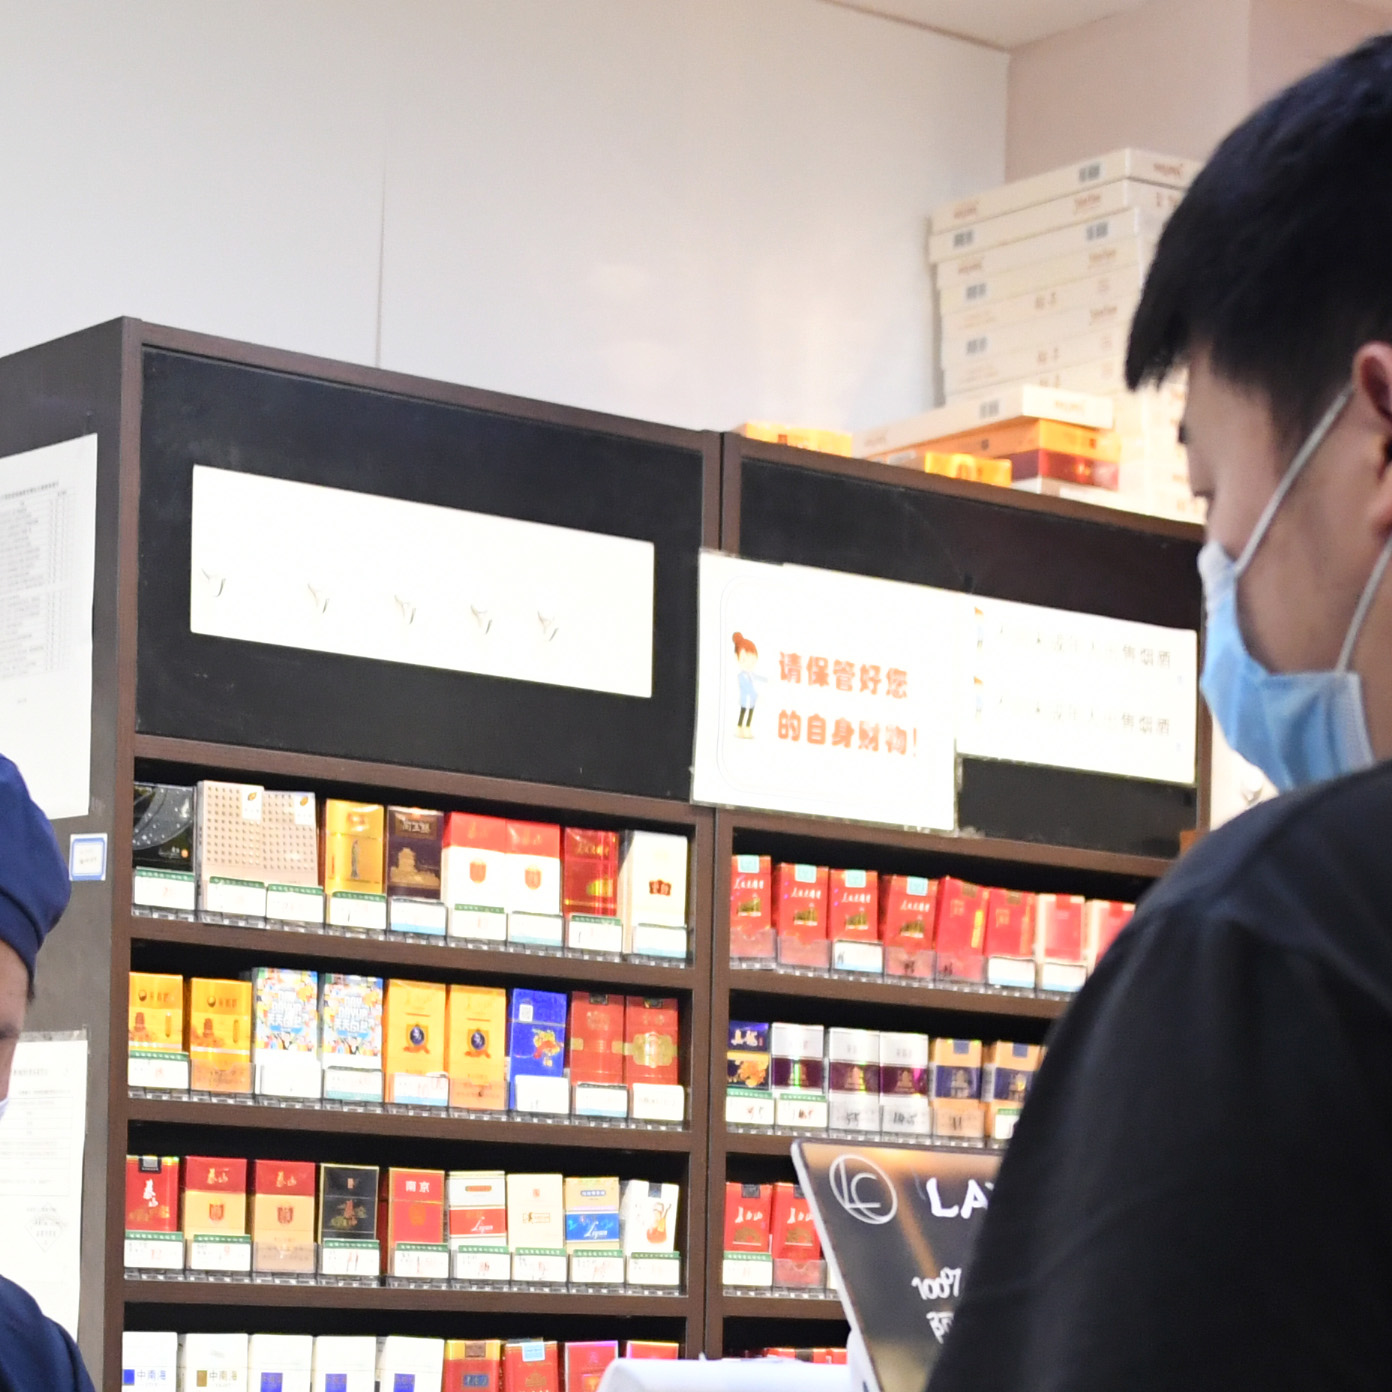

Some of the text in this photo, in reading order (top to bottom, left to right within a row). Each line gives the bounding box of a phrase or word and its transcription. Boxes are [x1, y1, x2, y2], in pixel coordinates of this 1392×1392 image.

[778, 651, 909, 699] 请保管好您
[404, 1180, 431, 1194] 南京
[925, 1177, 995, 1220] LA
[136, 1369, 167, 1381] 中南海
[208, 1369, 238, 1382] 中南海
